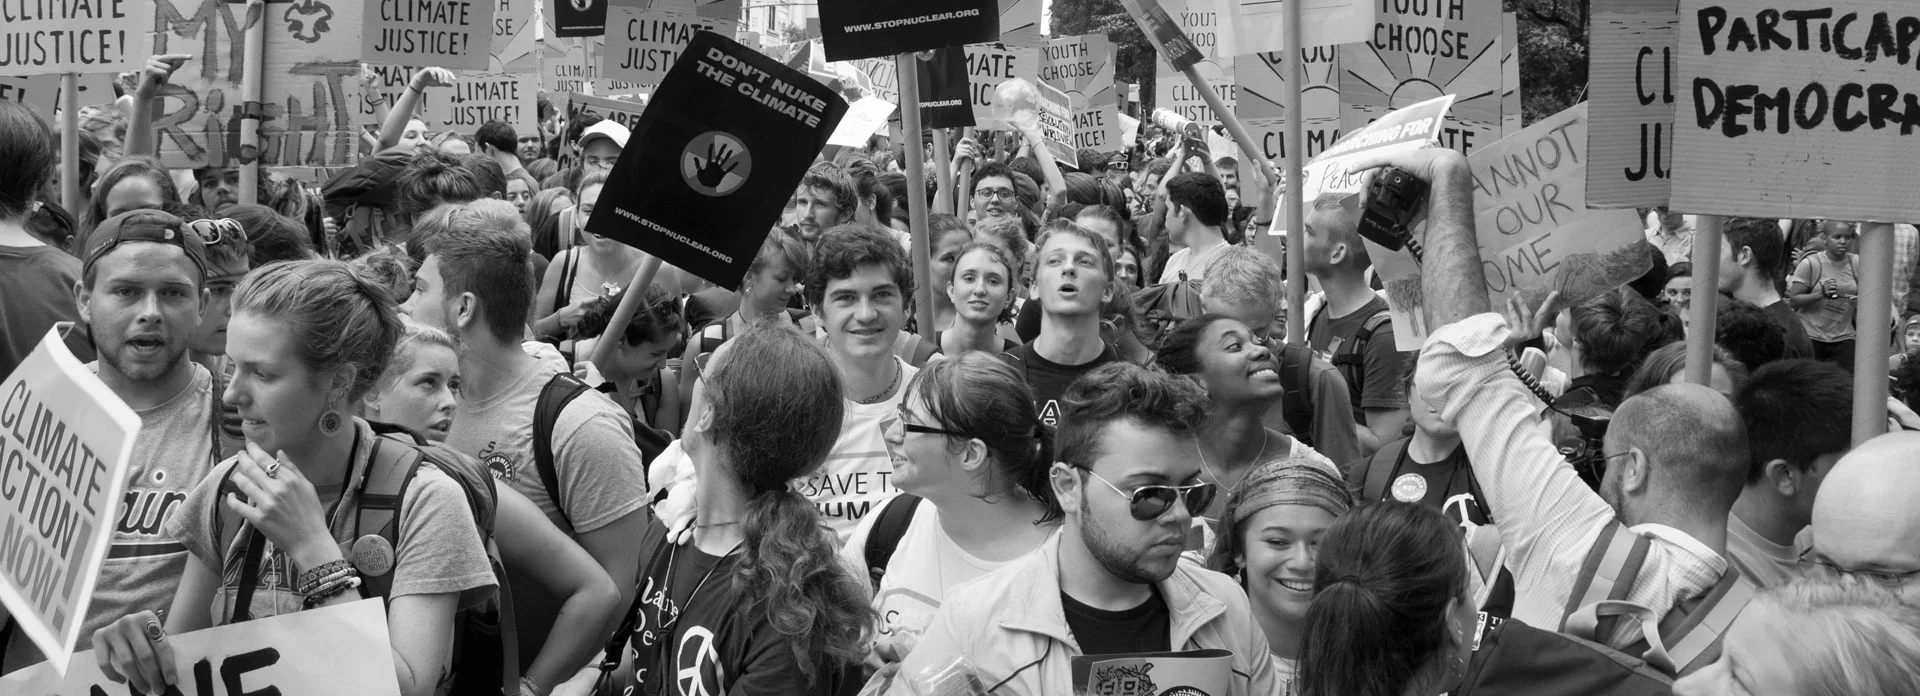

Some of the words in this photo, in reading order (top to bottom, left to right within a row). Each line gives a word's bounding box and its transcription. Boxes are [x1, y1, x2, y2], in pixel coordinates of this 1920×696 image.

[381, 0, 471, 25] CLIMATE
[844, 8, 980, 33] WWW.STOPNUCLEAR.ORG
[0, 29, 125, 66] JUSTICE!
[374, 28, 469, 55] JUSTICE!
[627, 18, 714, 45] CLIMAT
[1374, 22, 1469, 60] CHOOSE
[1697, 6, 1920, 70] PARTICAP
[1042, 42, 1088, 61] YOUTH
[706, 47, 771, 83] DON'T
[772, 78, 828, 113] NUKE
[1043, 61, 1094, 80] CHOOSE
[696, 60, 736, 87] THE
[738, 82, 822, 128] CLIMATE
[1400, 117, 1434, 139] FOR
[1496, 183, 1574, 235] OUR
[614, 206, 733, 264] WWW.STOPNUCLEAR.ORG
[1480, 233, 1560, 293] OME
[1, 379, 107, 517] CLIMATE
[805, 471, 868, 497] SAVE
